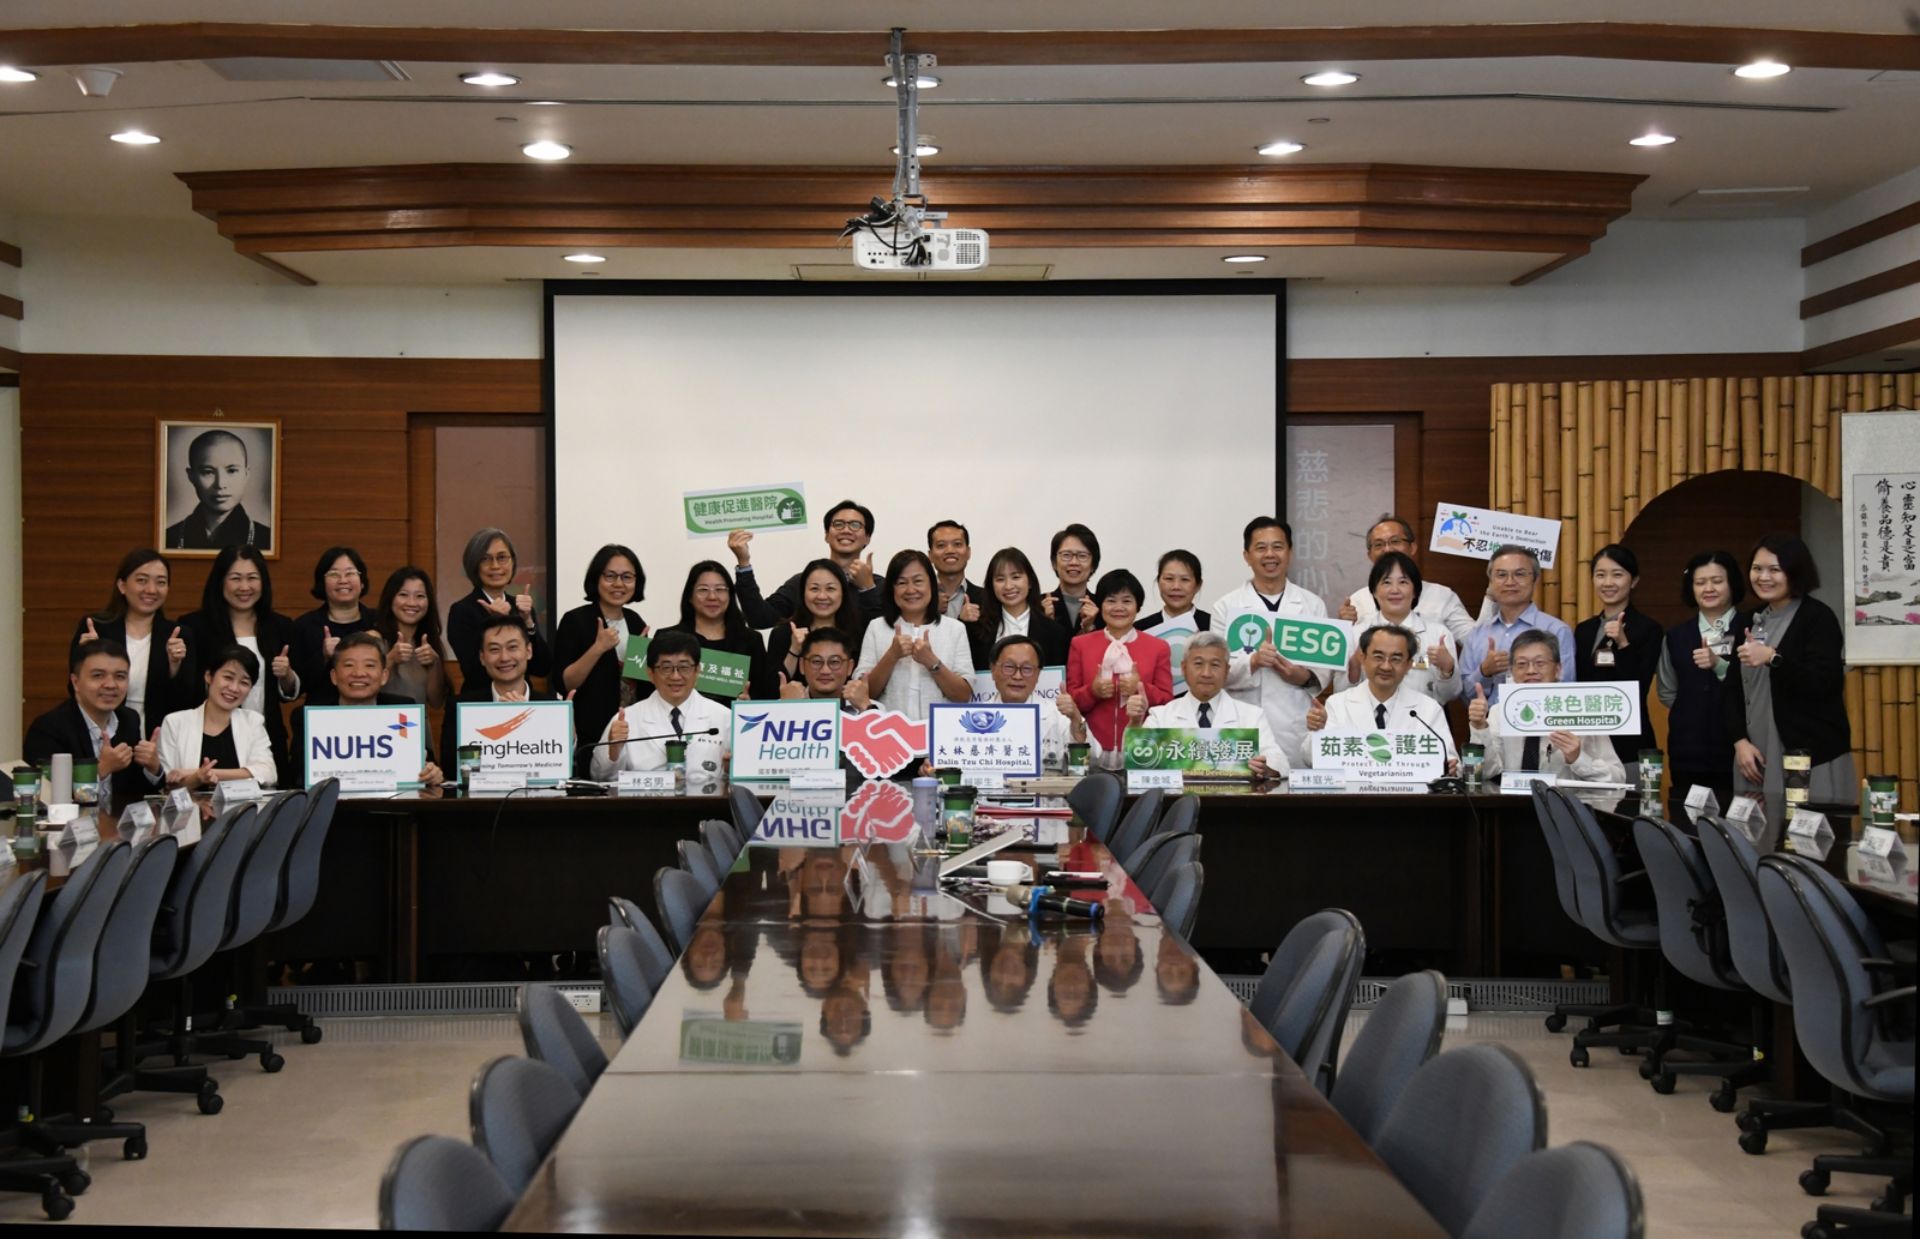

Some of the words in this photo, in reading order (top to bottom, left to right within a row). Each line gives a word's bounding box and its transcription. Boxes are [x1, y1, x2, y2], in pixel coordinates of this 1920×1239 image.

[693, 495, 778, 517] 健康促進醫院
[1296, 449, 1328, 597] 慈悲的心
[1281, 625, 1340, 656] ESG
[1544, 694, 1623, 713] 綠色醫院
[762, 719, 832, 742] NHG
[1546, 716, 1575, 725] Green
[1577, 716, 1618, 726] Hospital
[312, 735, 393, 759] NUHS
[758, 742, 829, 760] Health
[938, 744, 1031, 757] 大林慈濟醫院
[1166, 740, 1255, 761] 永續發展
[1320, 736, 1364, 757] 茹素
[1395, 734, 1440, 756] 護生
[978, 758, 993, 766] Chi
[995, 758, 1033, 767] Hospital,
[1359, 770, 1414, 778] Vegetarianism
